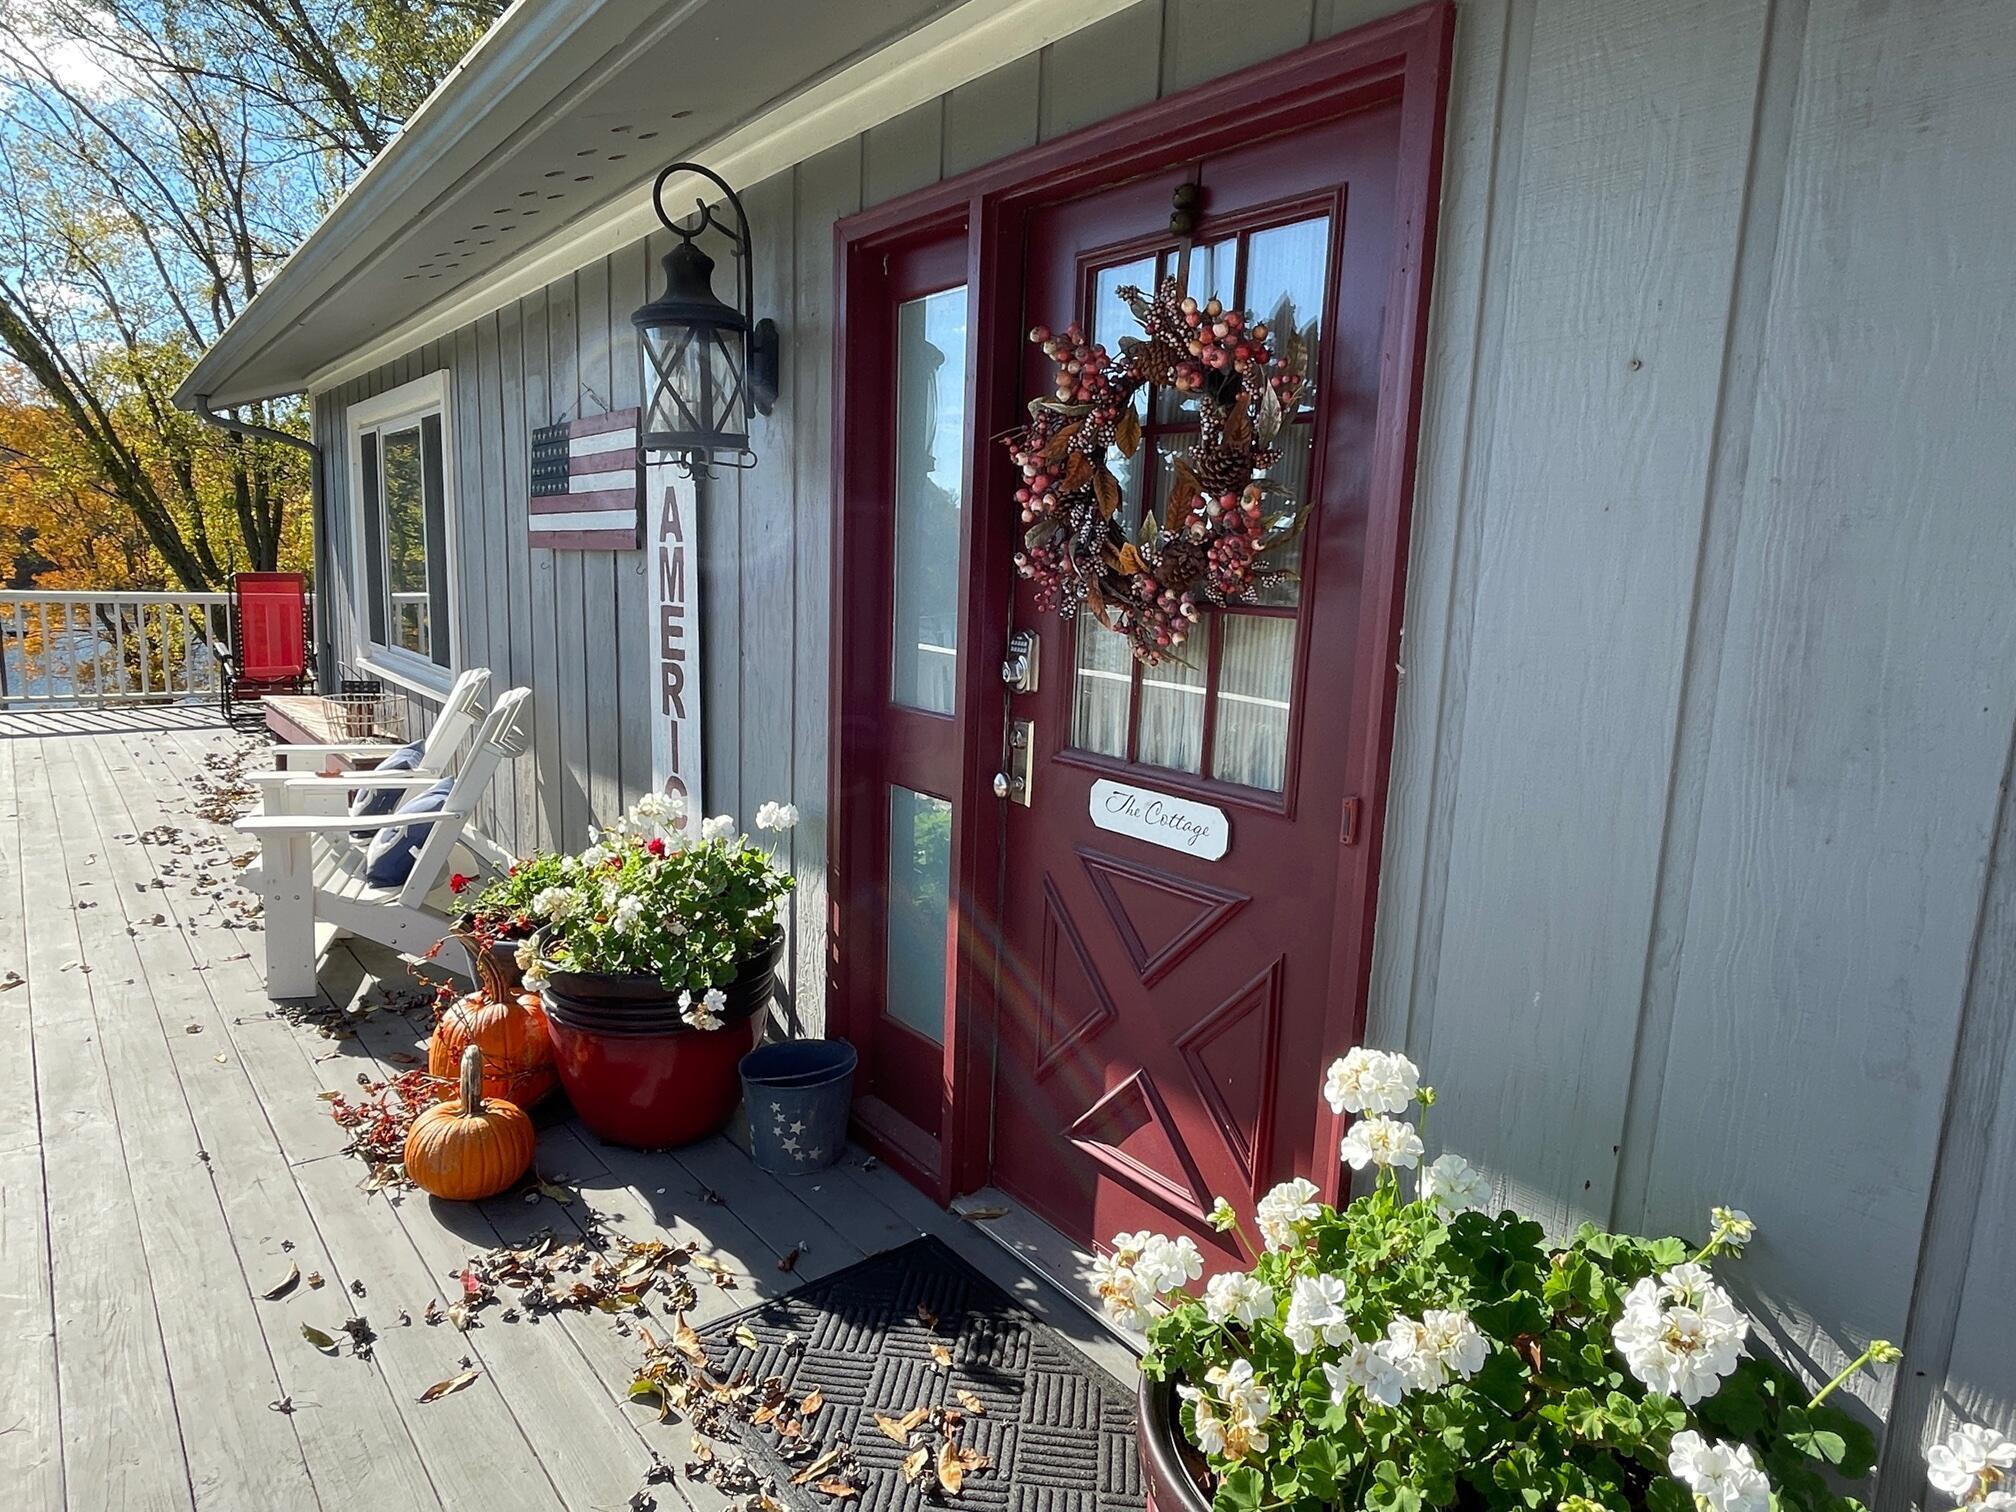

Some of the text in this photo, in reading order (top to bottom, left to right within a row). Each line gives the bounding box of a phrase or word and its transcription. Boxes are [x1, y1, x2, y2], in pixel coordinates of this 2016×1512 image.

[659, 486, 688, 831] AMERIC
[1105, 791, 1210, 846] The Cottage
